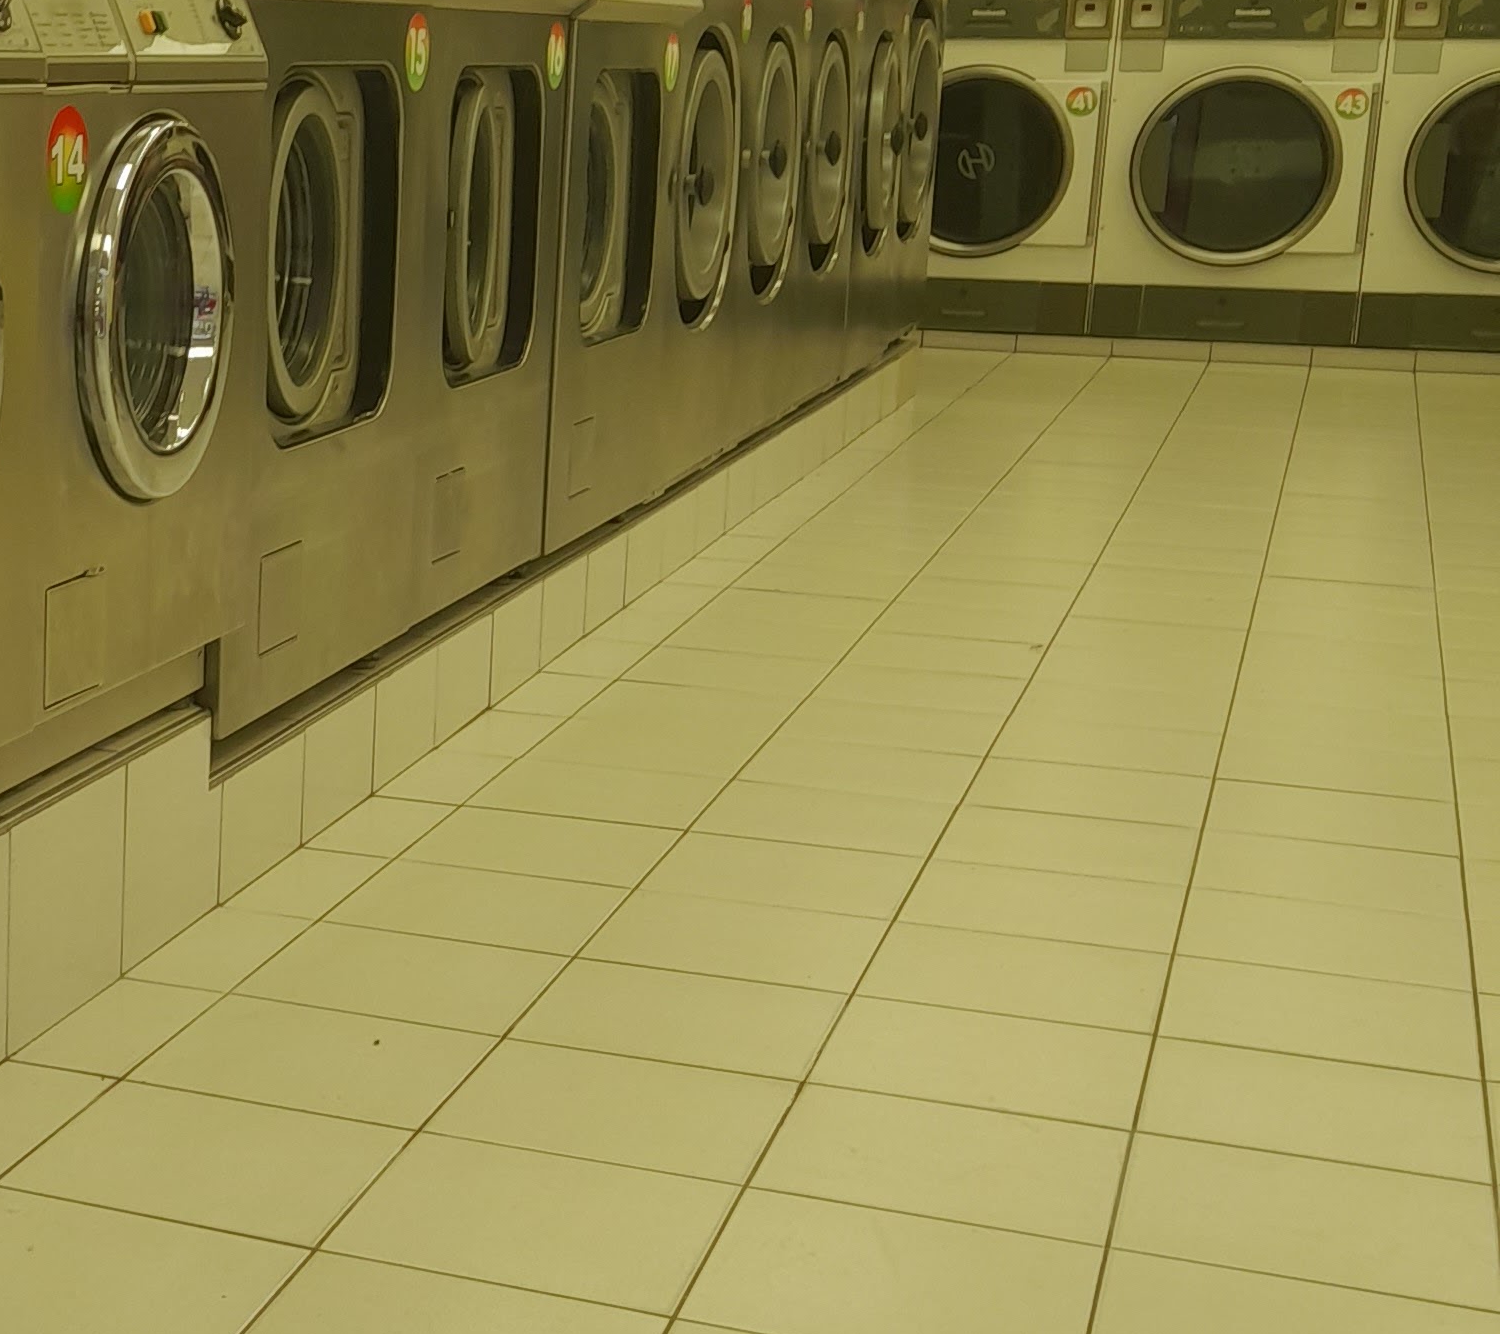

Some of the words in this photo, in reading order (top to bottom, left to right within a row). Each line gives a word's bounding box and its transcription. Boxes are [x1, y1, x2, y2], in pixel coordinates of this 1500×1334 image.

[409, 27, 427, 76] 15
[549, 33, 565, 75] 16
[1070, 89, 1095, 113] 41
[1338, 93, 1365, 116] 43
[51, 133, 86, 186] 14
